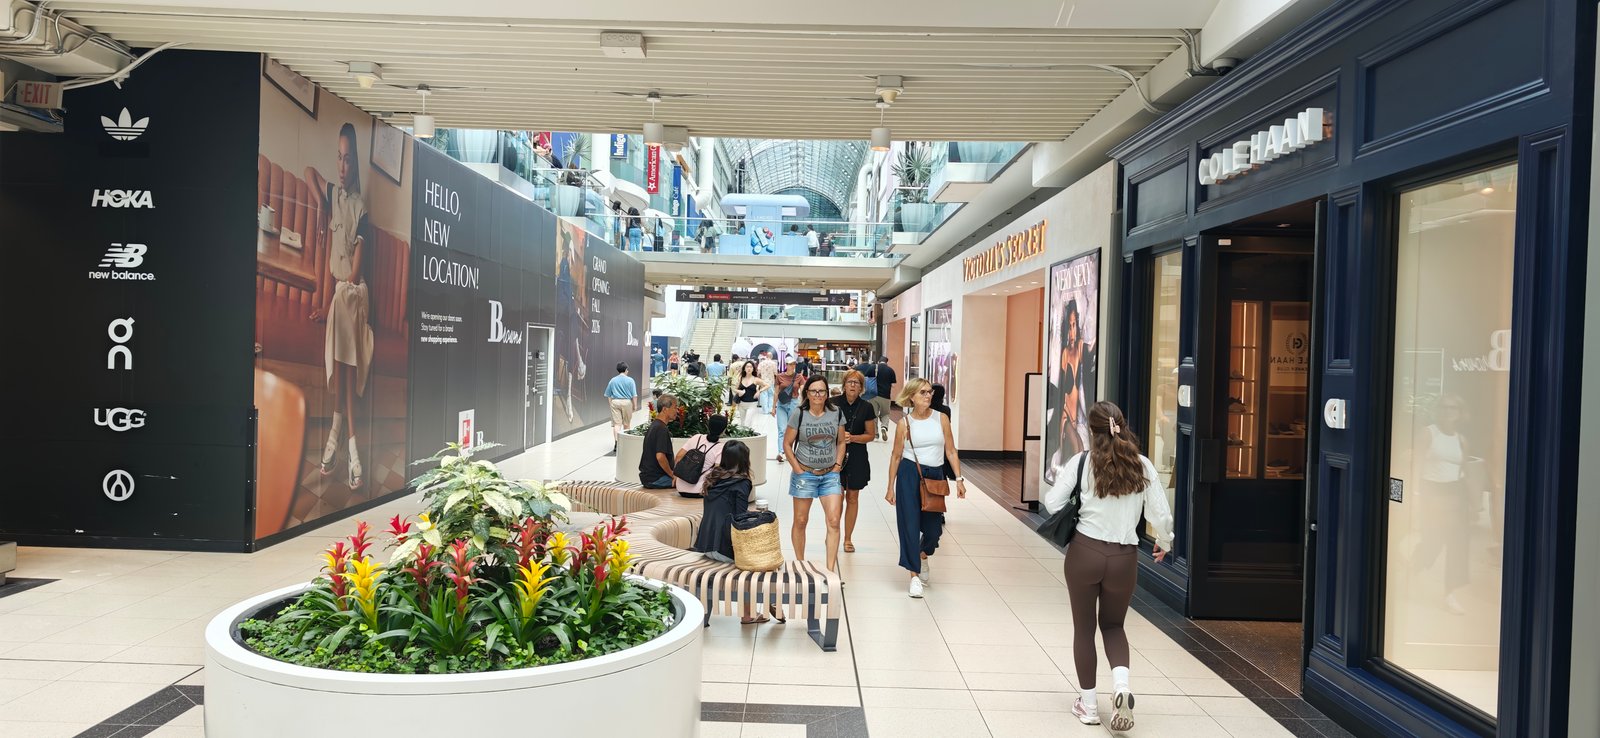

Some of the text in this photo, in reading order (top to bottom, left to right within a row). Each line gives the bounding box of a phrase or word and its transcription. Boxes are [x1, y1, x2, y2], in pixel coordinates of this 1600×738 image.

[24, 82, 51, 104] EXIT
[1250, 107, 1323, 164] HAAN
[649, 149, 657, 182] American
[91, 189, 155, 209] HOKA
[425, 179, 461, 222] HELLO,
[424, 217, 450, 248] NEW
[963, 218, 1048, 283] VICTORIA'S SECRET
[89, 271, 110, 279] new
[423, 255, 479, 290] LOCATION!
[592, 255, 607, 274] GRAND
[1055, 261, 1092, 291] VERY SEXY
[592, 298, 600, 313] FALL
[93, 407, 147, 432] UGG
[805, 426, 836, 438] GRAND
[808, 446, 833, 456] BEACH
